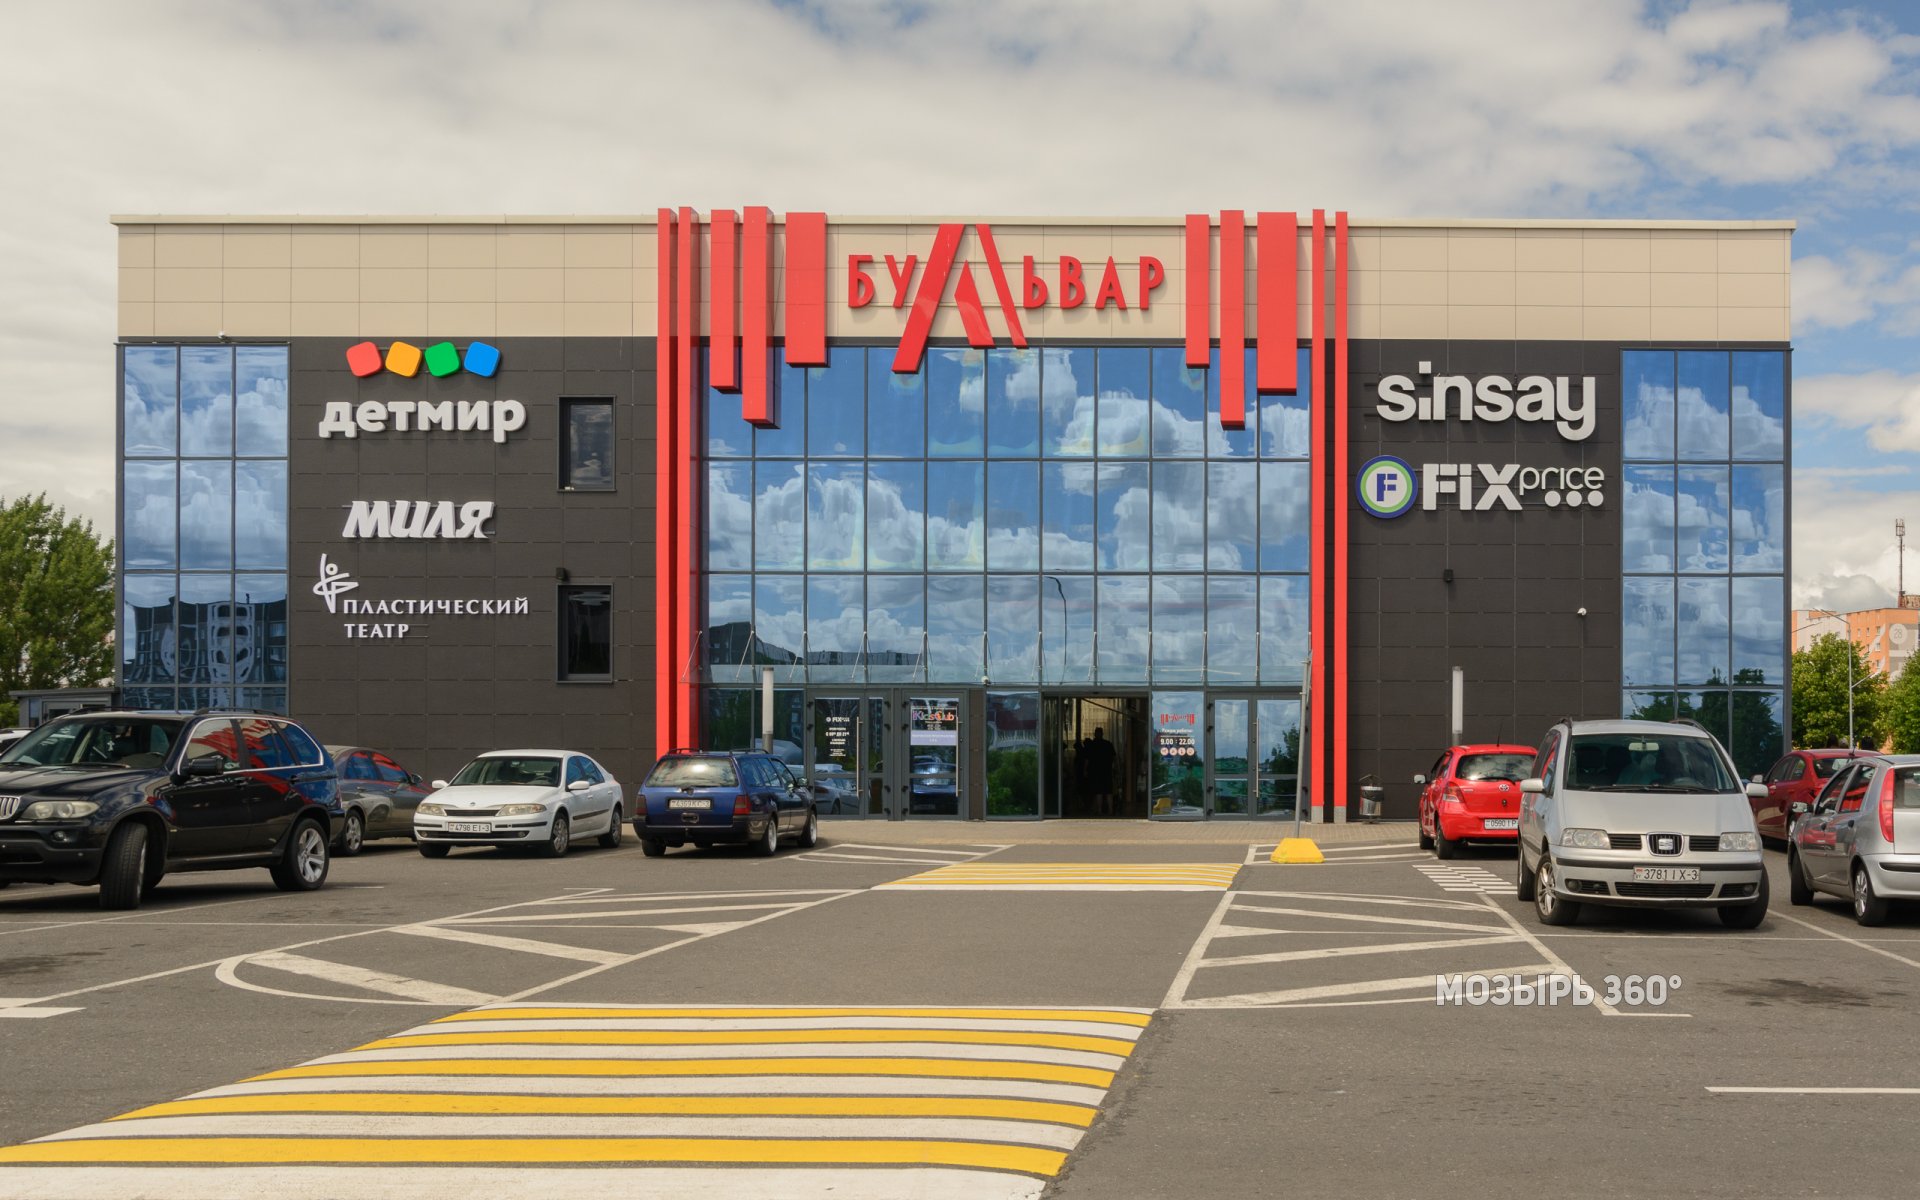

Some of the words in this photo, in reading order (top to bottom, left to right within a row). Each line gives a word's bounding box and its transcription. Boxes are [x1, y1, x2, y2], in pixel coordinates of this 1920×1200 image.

[848, 224, 1165, 374] БУЛЬВАР
[1377, 361, 1596, 441] sinsay
[319, 400, 526, 443] детмир
[1519, 466, 1606, 496] price
[343, 596, 529, 615] ПЛАСТИЧЕСКИЙ
[344, 623, 409, 638] ТЕАТР
